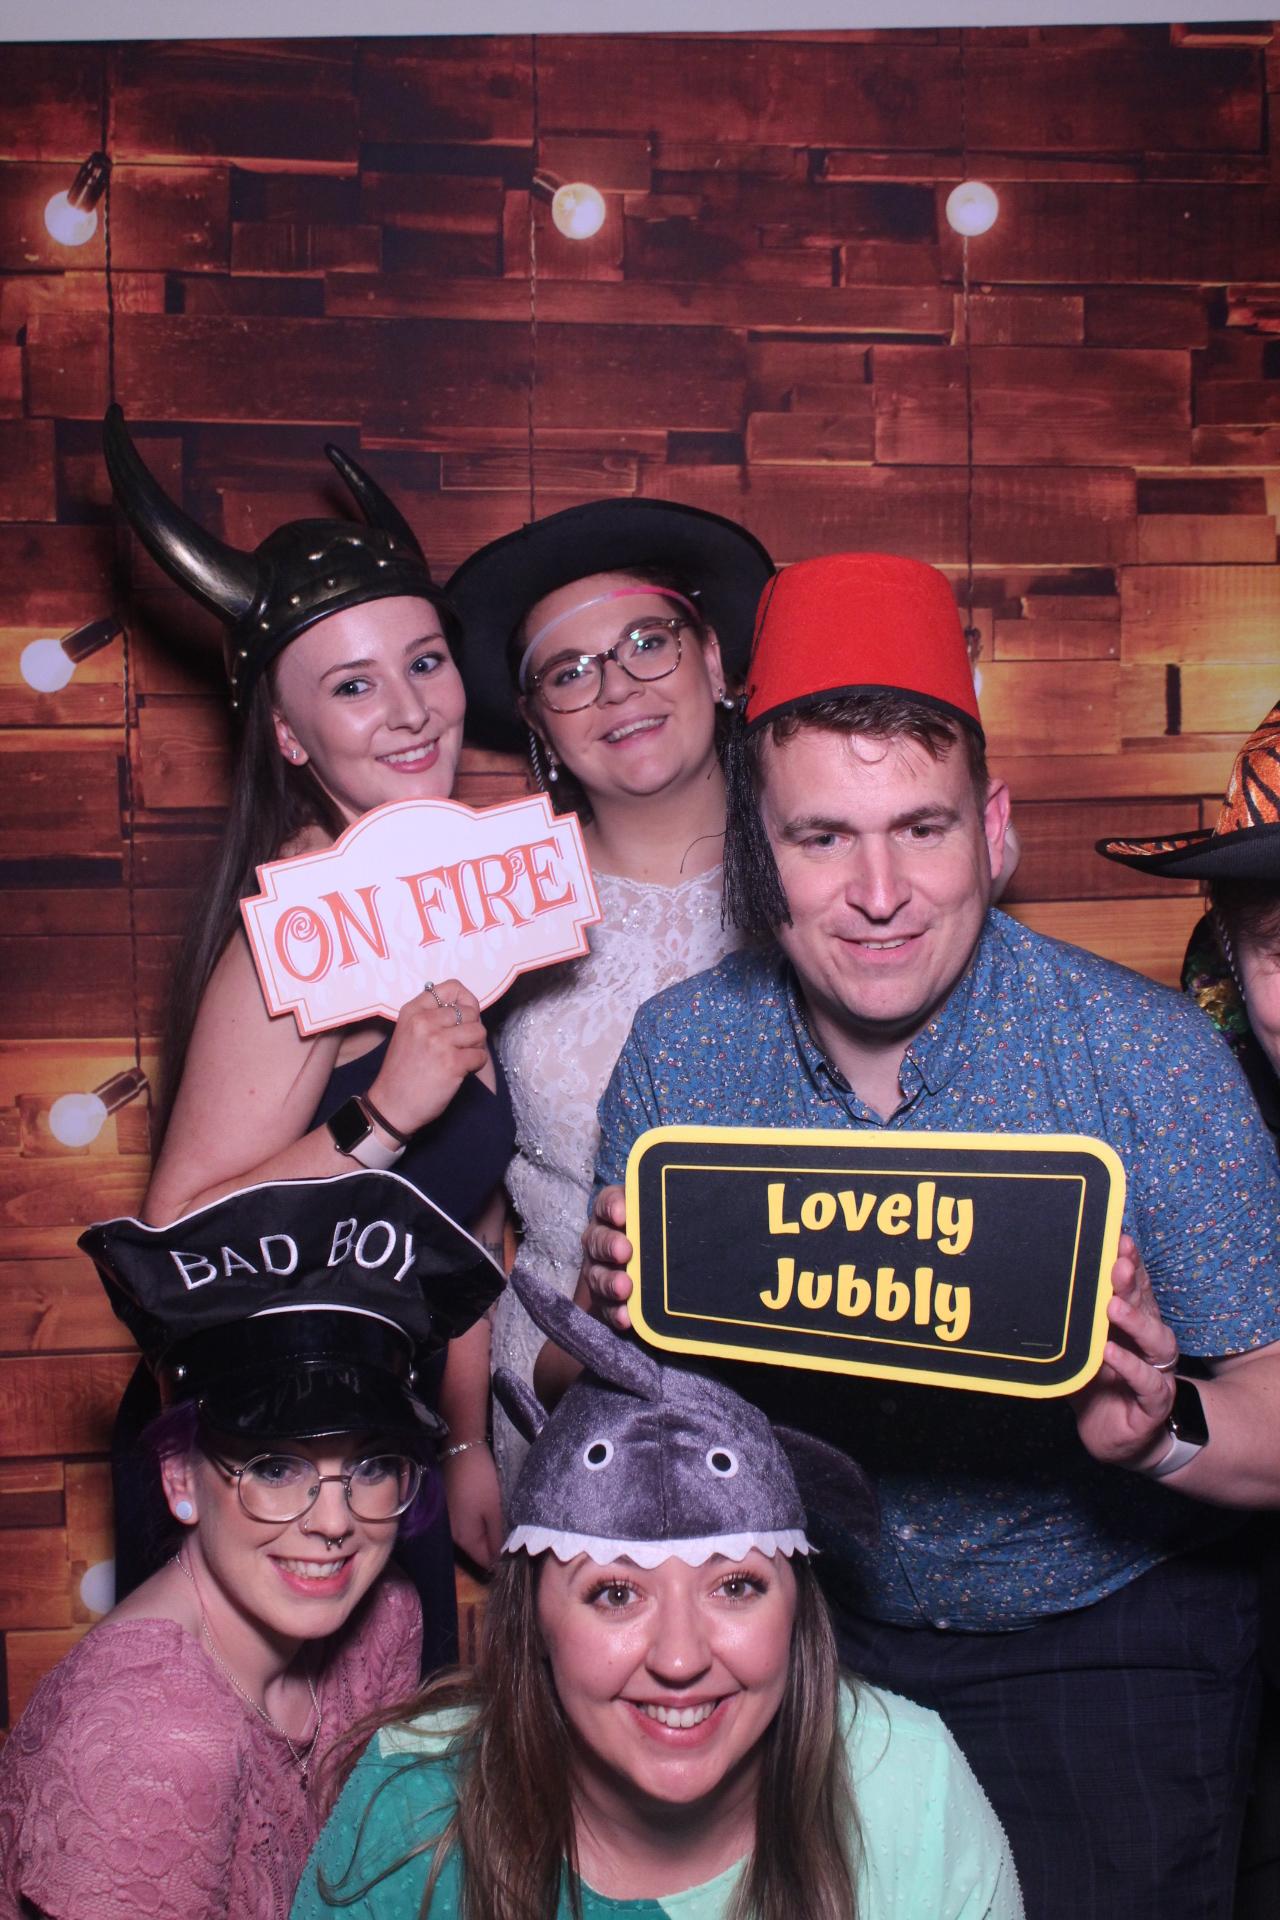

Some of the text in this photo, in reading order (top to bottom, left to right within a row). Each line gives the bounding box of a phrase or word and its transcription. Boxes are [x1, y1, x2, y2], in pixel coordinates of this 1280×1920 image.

[274, 836, 577, 983] ON FIRE
[170, 1217, 416, 1290] BAD BOY
[767, 1181, 974, 1255] Lovely
[759, 1258, 971, 1342] Jubbly
